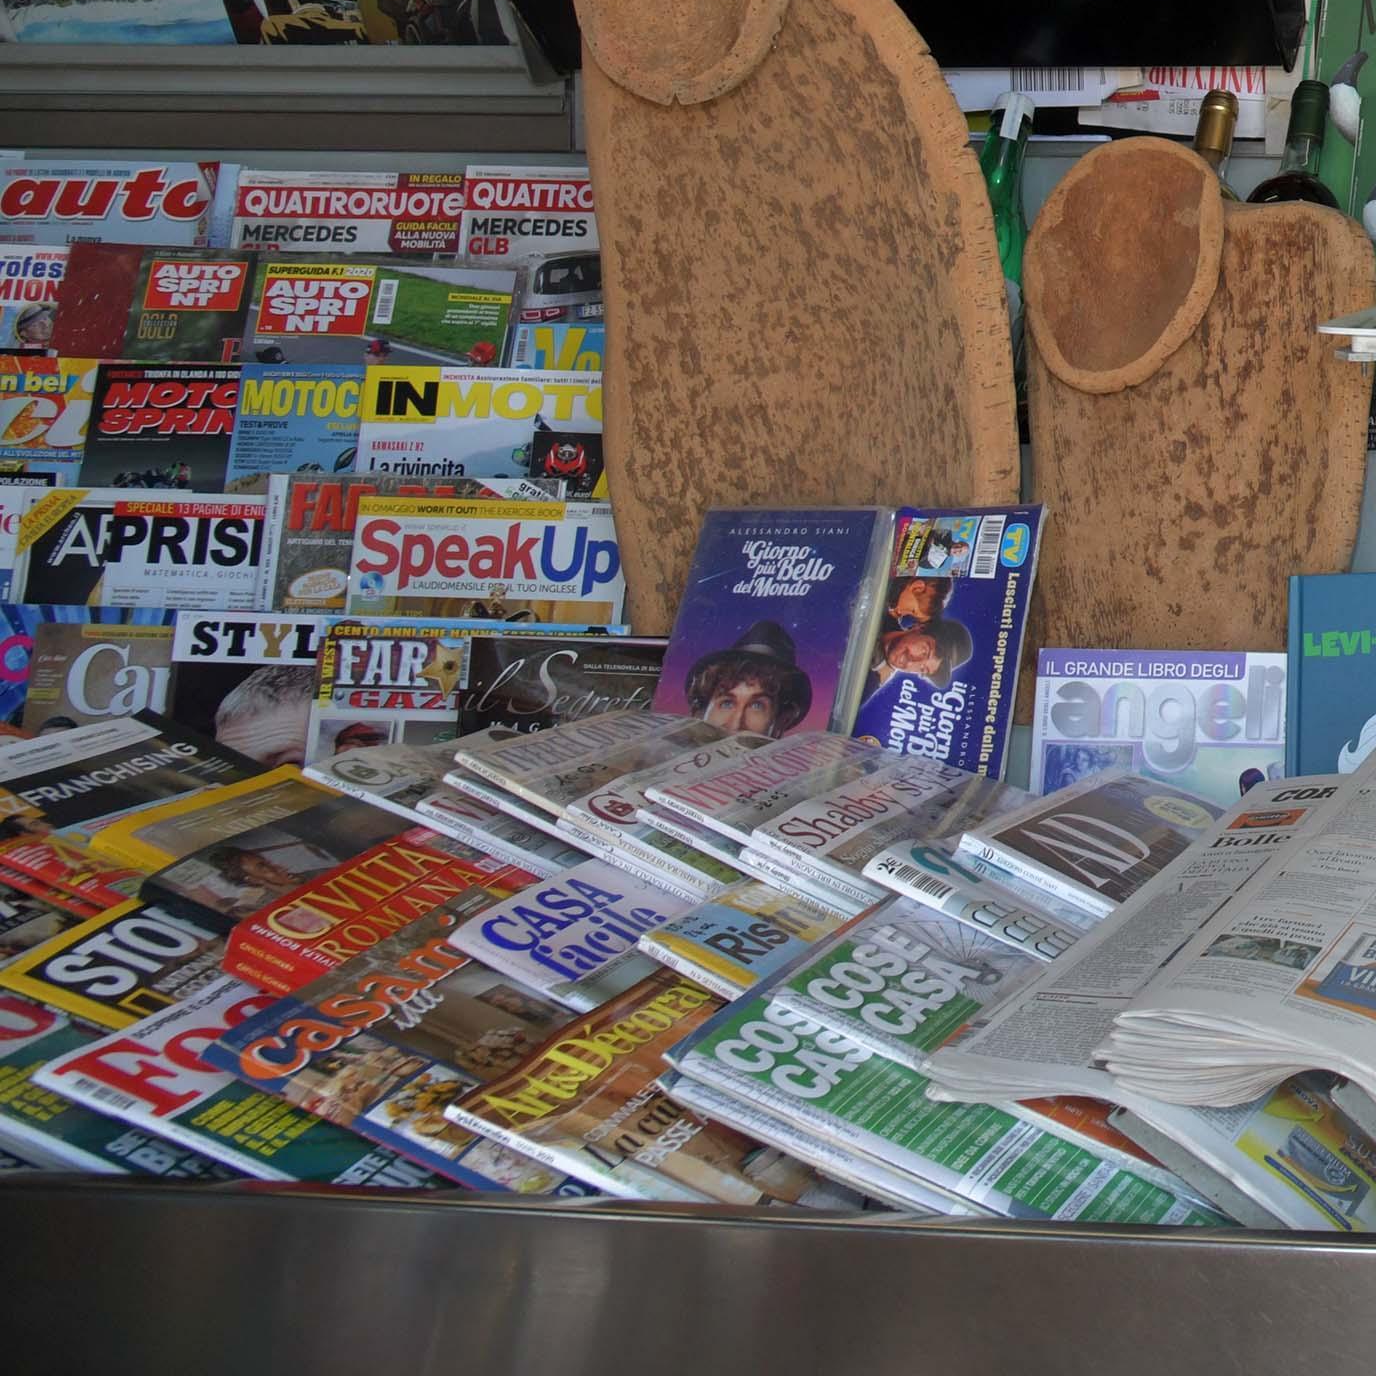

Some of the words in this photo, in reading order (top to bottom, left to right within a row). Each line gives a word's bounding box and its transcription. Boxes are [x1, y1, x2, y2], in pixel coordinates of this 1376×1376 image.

[244, 190, 465, 219] QUATTRORUOTE
[242, 225, 357, 243] MERCEDES
[265, 280, 369, 297] AUTO
[261, 298, 358, 317] SPRI
[285, 316, 334, 332] NT
[356, 520, 621, 597] SpeakUp
[1050, 662, 1285, 769] angeli
[25, 740, 198, 806] FRANCHISING
